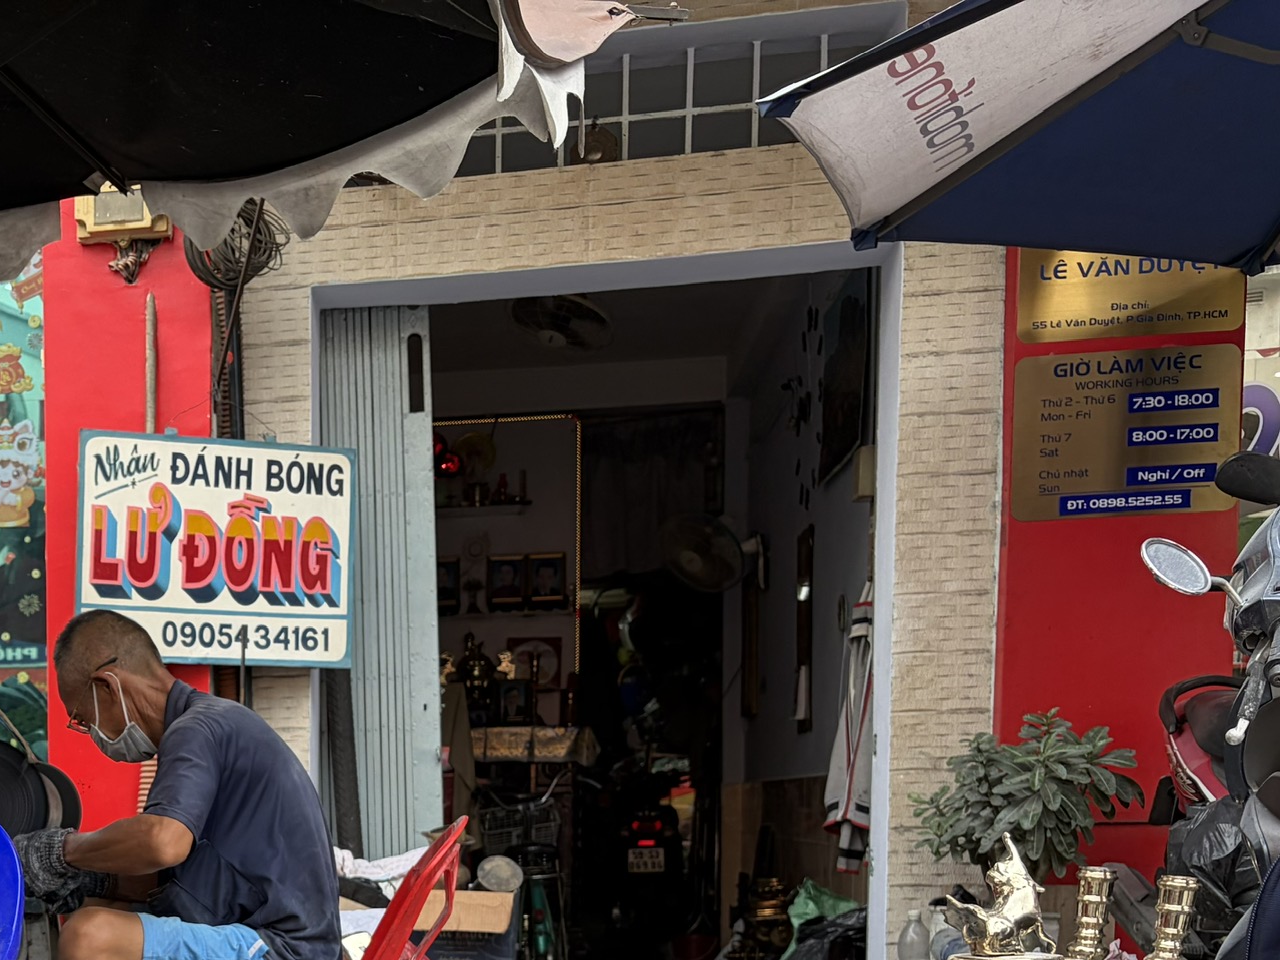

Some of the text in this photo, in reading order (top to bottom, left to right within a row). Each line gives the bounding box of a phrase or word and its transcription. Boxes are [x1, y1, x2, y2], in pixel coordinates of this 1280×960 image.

[1040, 259, 1068, 281] LÊ
[1077, 256, 1131, 279] VĂN
[1111, 300, 1150, 312] Địa chỉ:
[1032, 320, 1048, 330] 55
[1187, 309, 1229, 320] TP.HCM
[1053, 352, 1202, 378] GIỜ LÀM VIỆC
[1075, 375, 1179, 391] WORKING HOURS
[1065, 397, 1073, 407] 2
[1107, 394, 1116, 404] 6
[1132, 396, 1166, 409] 7:30
[1174, 393, 1214, 406] 18:00
[1040, 413, 1065, 422] Mon
[1075, 410, 1092, 419] Fri
[1064, 433, 1072, 442] 7
[1132, 430, 1167, 442] 8:00
[1176, 427, 1214, 440] 17:00
[1039, 447, 1059, 458] Sat
[170, 446, 253, 491] ĐÁNH
[265, 453, 344, 497] BÓNG
[1183, 468, 1206, 478] Off
[1038, 484, 1061, 494] Sun
[1066, 494, 1183, 511] ĐT: 0898.5252.55
[89, 481, 343, 608] LƯ ĐỒNG
[161, 620, 330, 653] 0905434161
